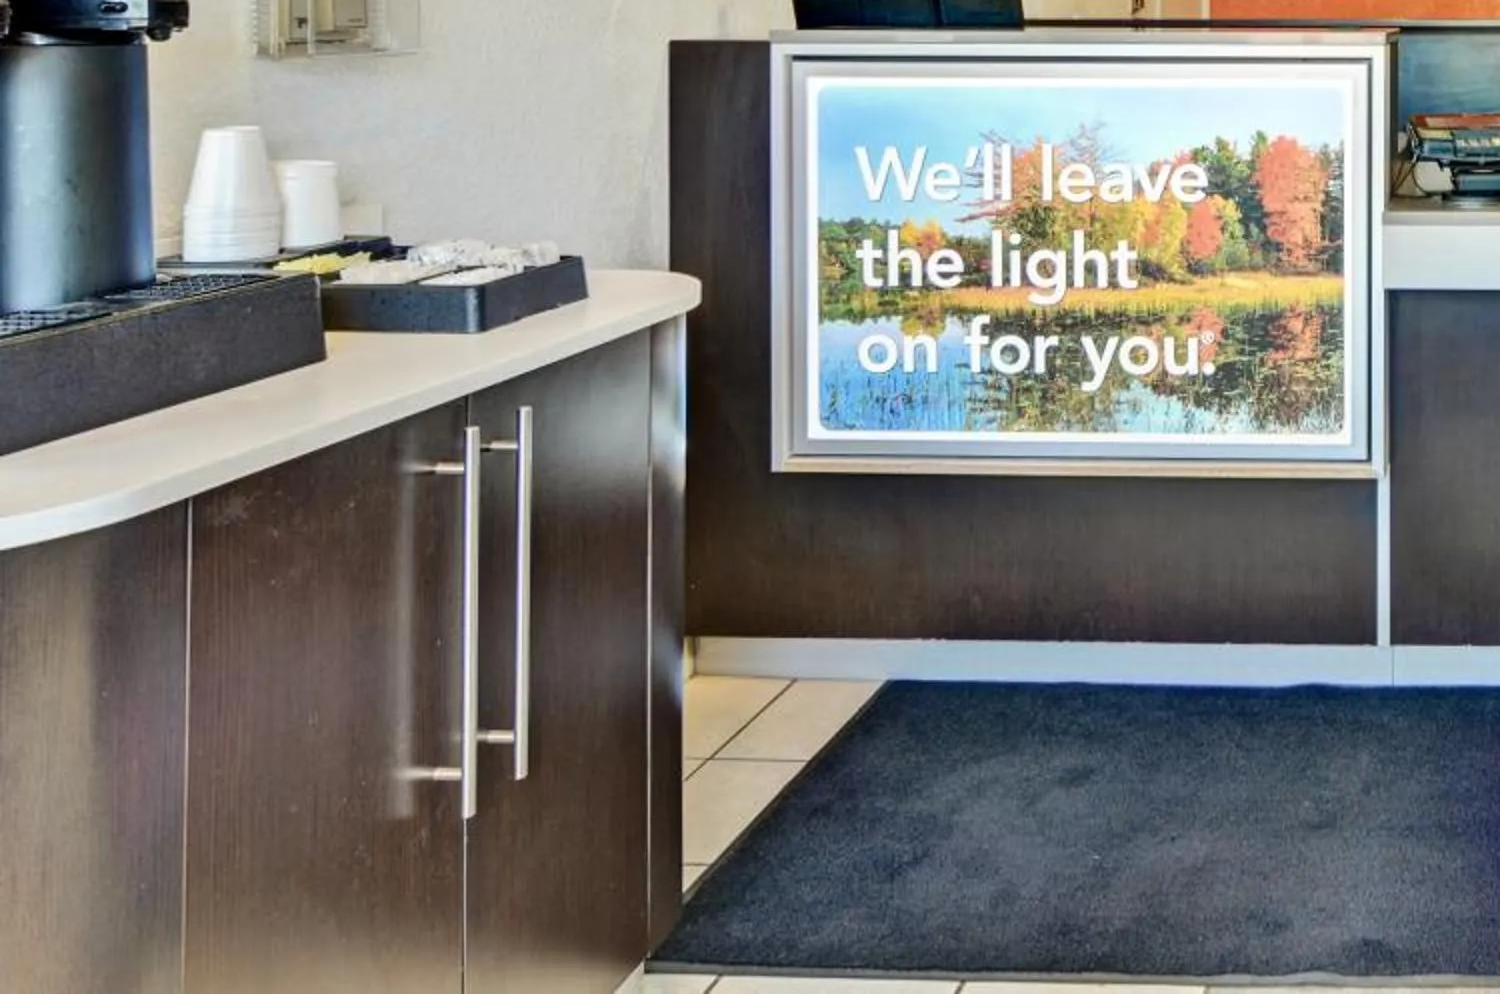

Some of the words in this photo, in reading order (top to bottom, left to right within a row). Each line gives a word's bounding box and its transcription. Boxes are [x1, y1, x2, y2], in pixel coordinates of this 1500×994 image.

[1040, 142, 1209, 203] leave
[855, 229, 965, 289] the
[990, 229, 1139, 306] light
[856, 331, 939, 375] on
[963, 314, 1061, 374] for
